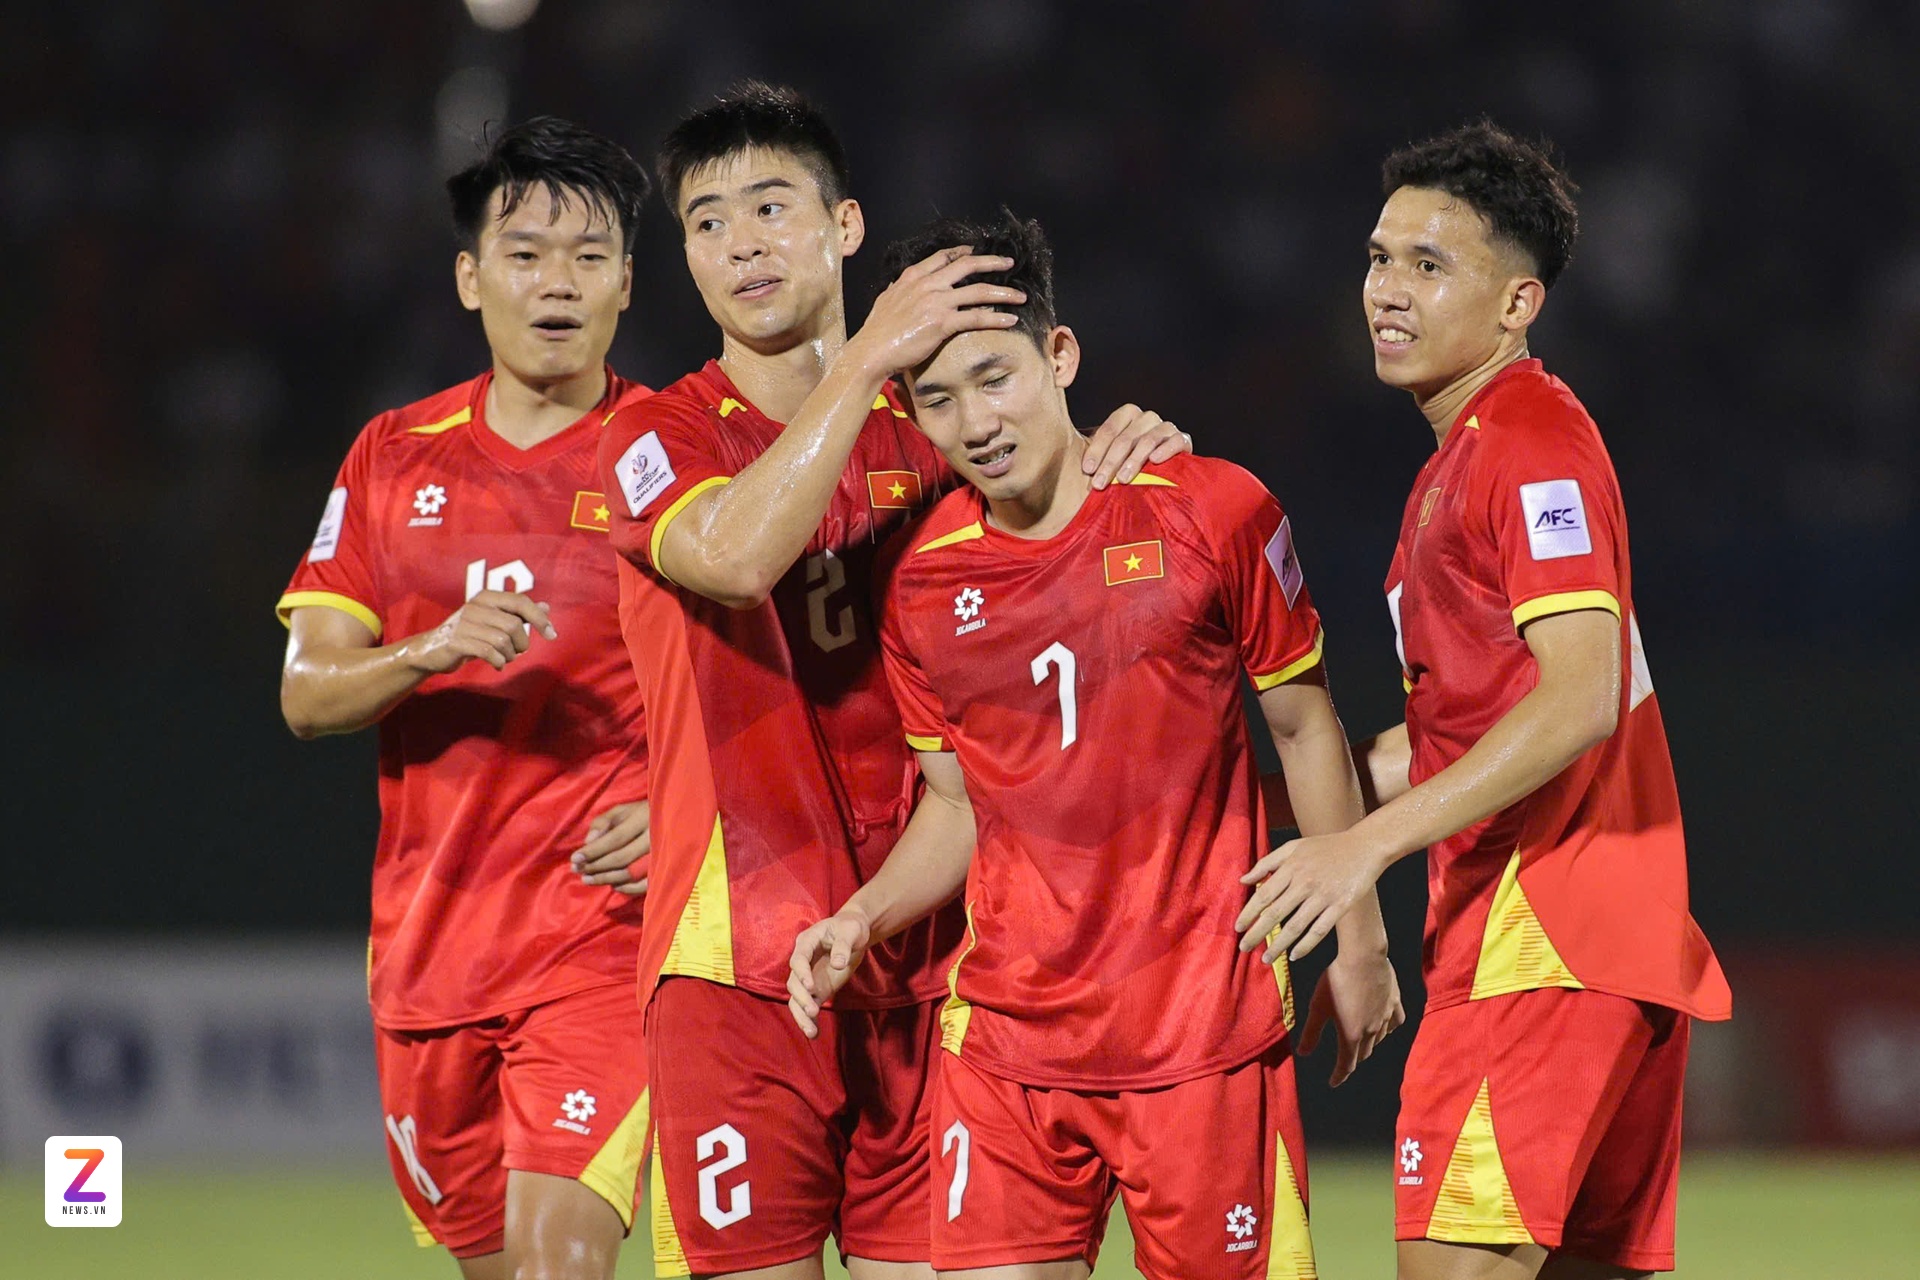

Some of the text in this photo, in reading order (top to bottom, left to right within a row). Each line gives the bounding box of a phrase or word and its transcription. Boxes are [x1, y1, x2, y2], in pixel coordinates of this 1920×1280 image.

[633, 471, 667, 504] QUALIFIERS
[1534, 507, 1576, 528] AFC
[806, 547, 857, 653] 2
[1030, 641, 1077, 750] 7
[696, 1123, 752, 1230] 2
[942, 1119, 970, 1222] 7
